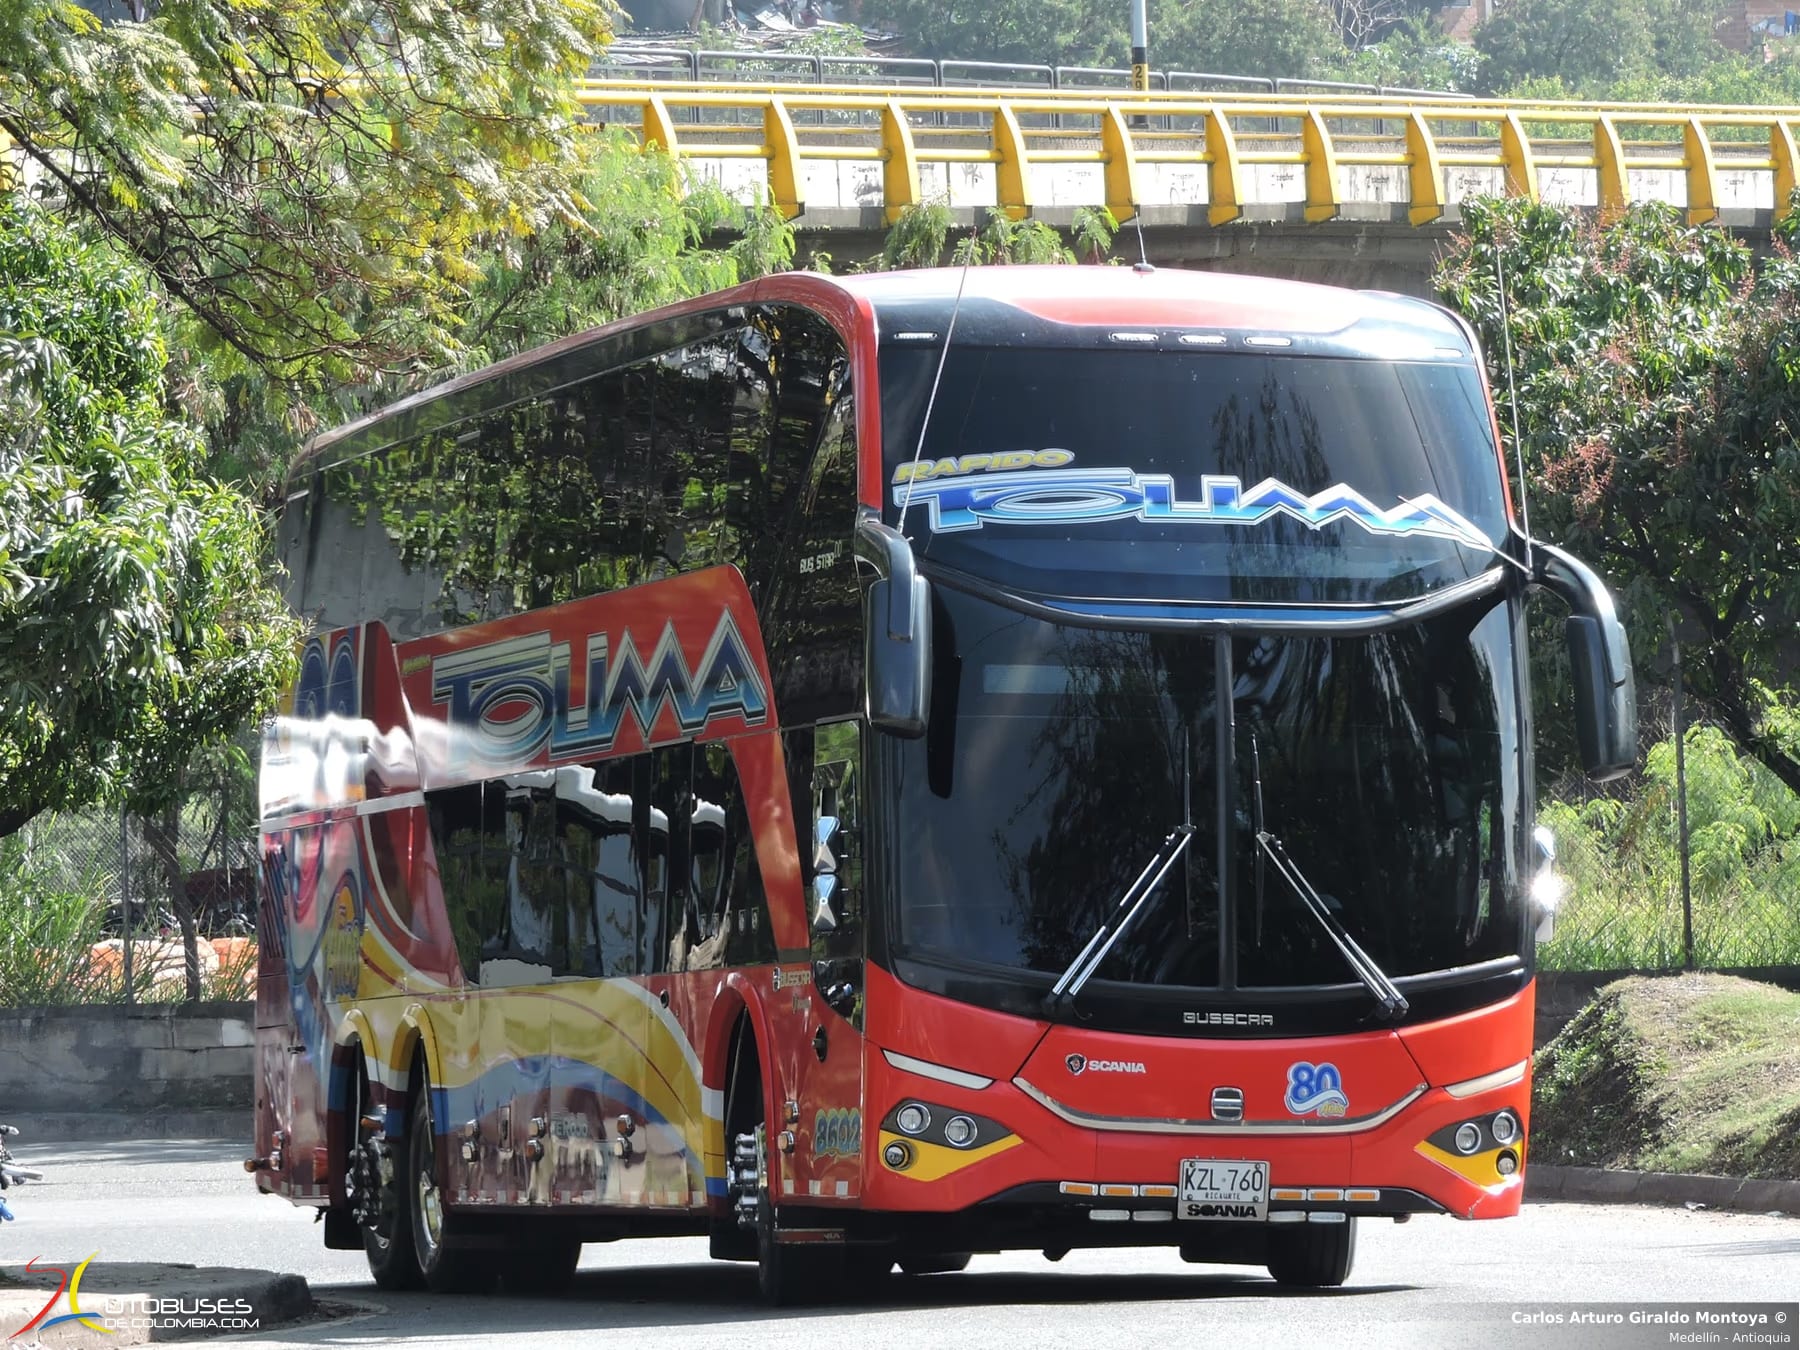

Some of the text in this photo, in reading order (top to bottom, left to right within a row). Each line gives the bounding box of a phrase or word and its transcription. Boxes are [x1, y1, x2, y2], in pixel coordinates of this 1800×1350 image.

[891, 448, 1075, 484] RAPIDO
[800, 556, 815, 574] BUS
[432, 605, 768, 770] TOLIMA
[1183, 1012, 1274, 1026] BUSSCAR
[1088, 1060, 1147, 1074] SCANIA
[1289, 1062, 1341, 1103] 80
[1187, 1203, 1258, 1218] SCANIA
